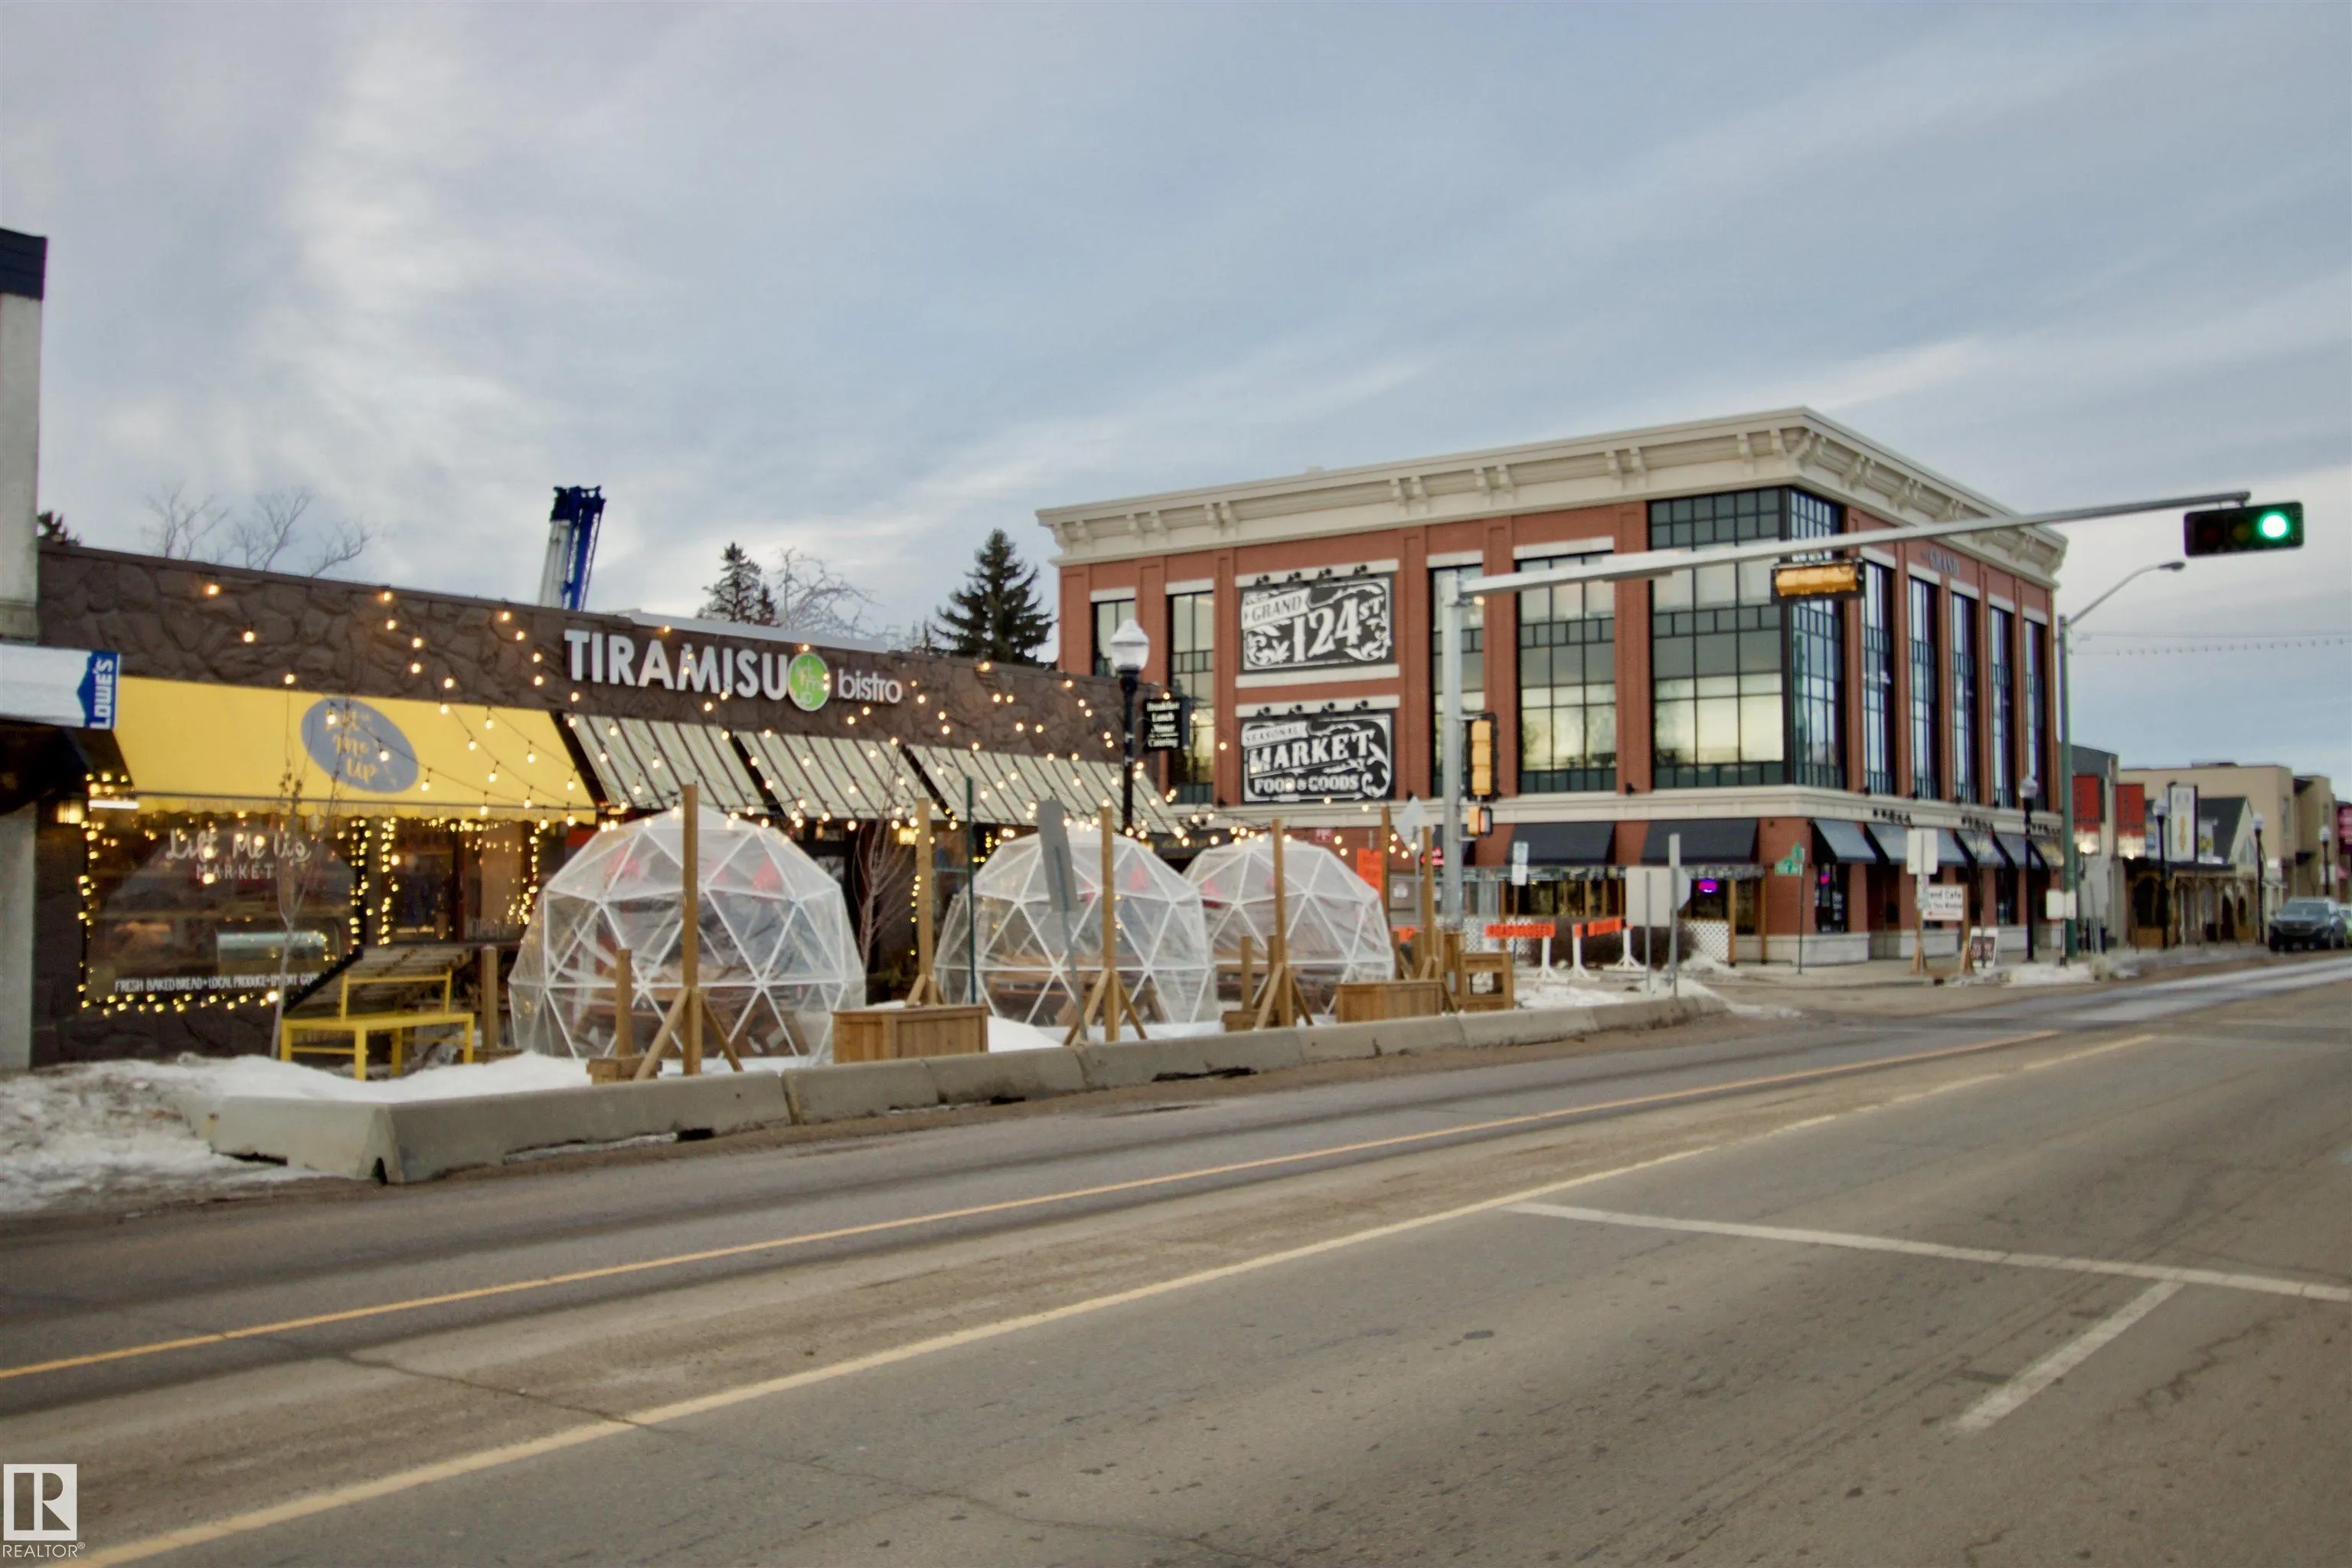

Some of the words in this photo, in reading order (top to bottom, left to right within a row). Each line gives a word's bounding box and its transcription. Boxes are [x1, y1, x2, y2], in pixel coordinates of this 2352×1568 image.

[1252, 595, 1302, 622] GRAND
[1292, 598, 1361, 662] 124
[564, 629, 788, 701] TIRAMISU
[90, 655, 114, 730] LOWE'S
[838, 668, 903, 704] bistro
[1152, 711, 1174, 722] Lunch
[1249, 728, 1376, 775] MARKET
[1253, 776, 1295, 795] FOOD
[1308, 773, 1360, 792] GOODS
[196, 862, 274, 880] MARKET
